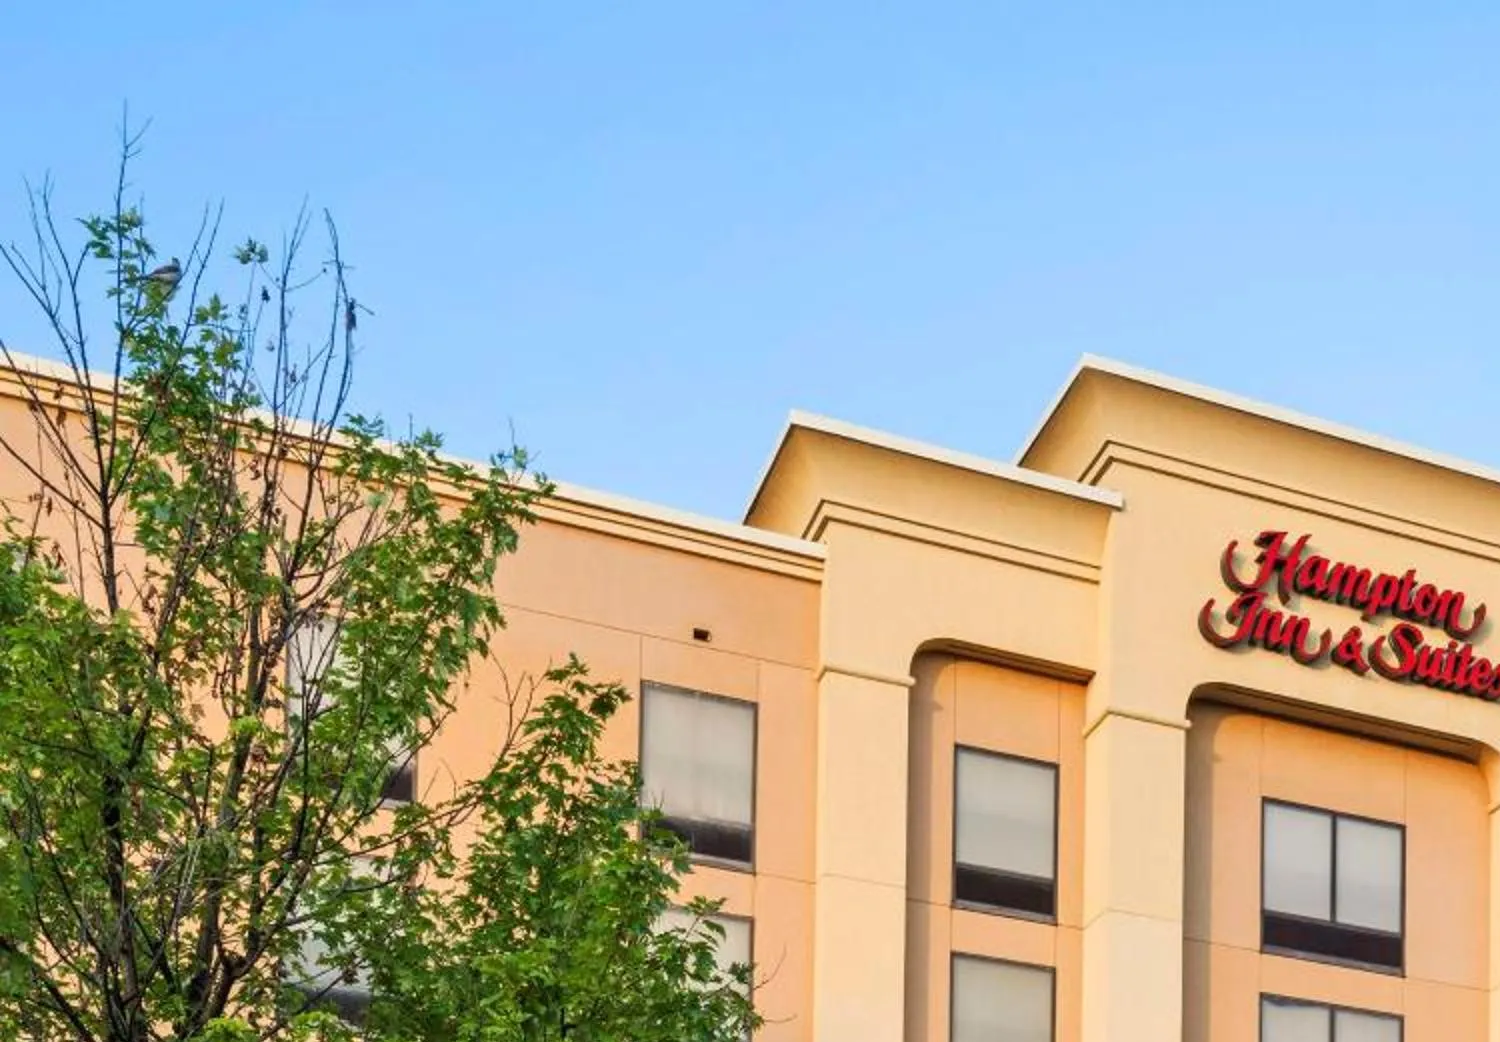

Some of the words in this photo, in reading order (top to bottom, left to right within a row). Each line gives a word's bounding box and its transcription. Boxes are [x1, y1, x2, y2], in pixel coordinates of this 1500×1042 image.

[1198, 592, 1332, 665] Inn
[1331, 625, 1370, 675] &
[1220, 531, 1486, 640] Hampton
